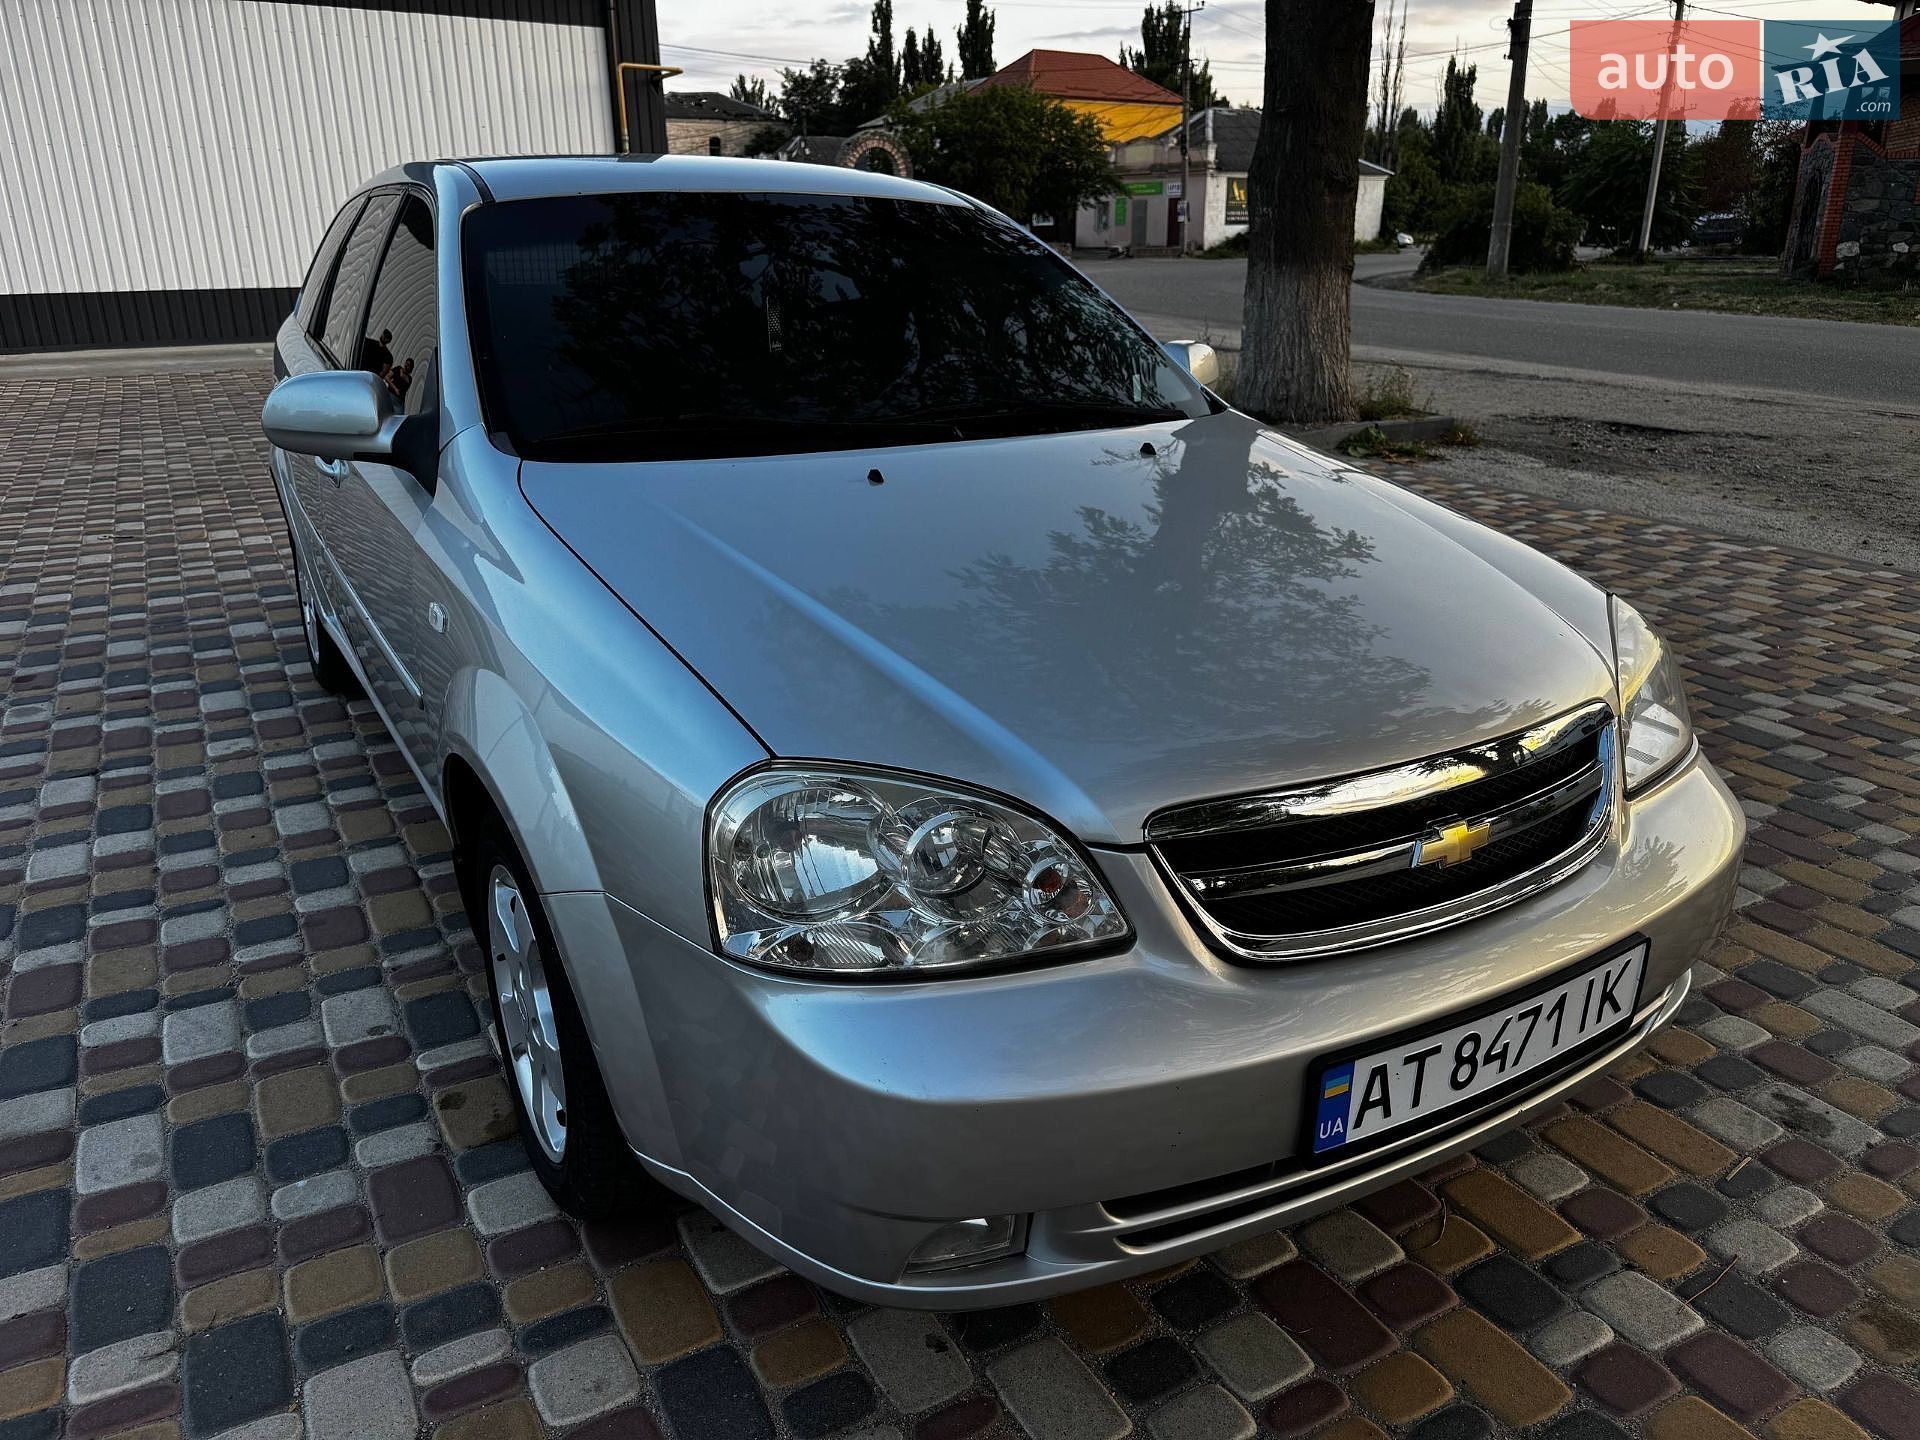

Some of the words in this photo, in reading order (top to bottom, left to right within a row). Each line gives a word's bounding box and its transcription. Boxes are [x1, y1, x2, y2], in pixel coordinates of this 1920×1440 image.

[1352, 1042, 1443, 1130] AT
[1449, 991, 1569, 1091] 8471
[1578, 957, 1633, 1034] IK
[1319, 1117, 1344, 1140] UA
